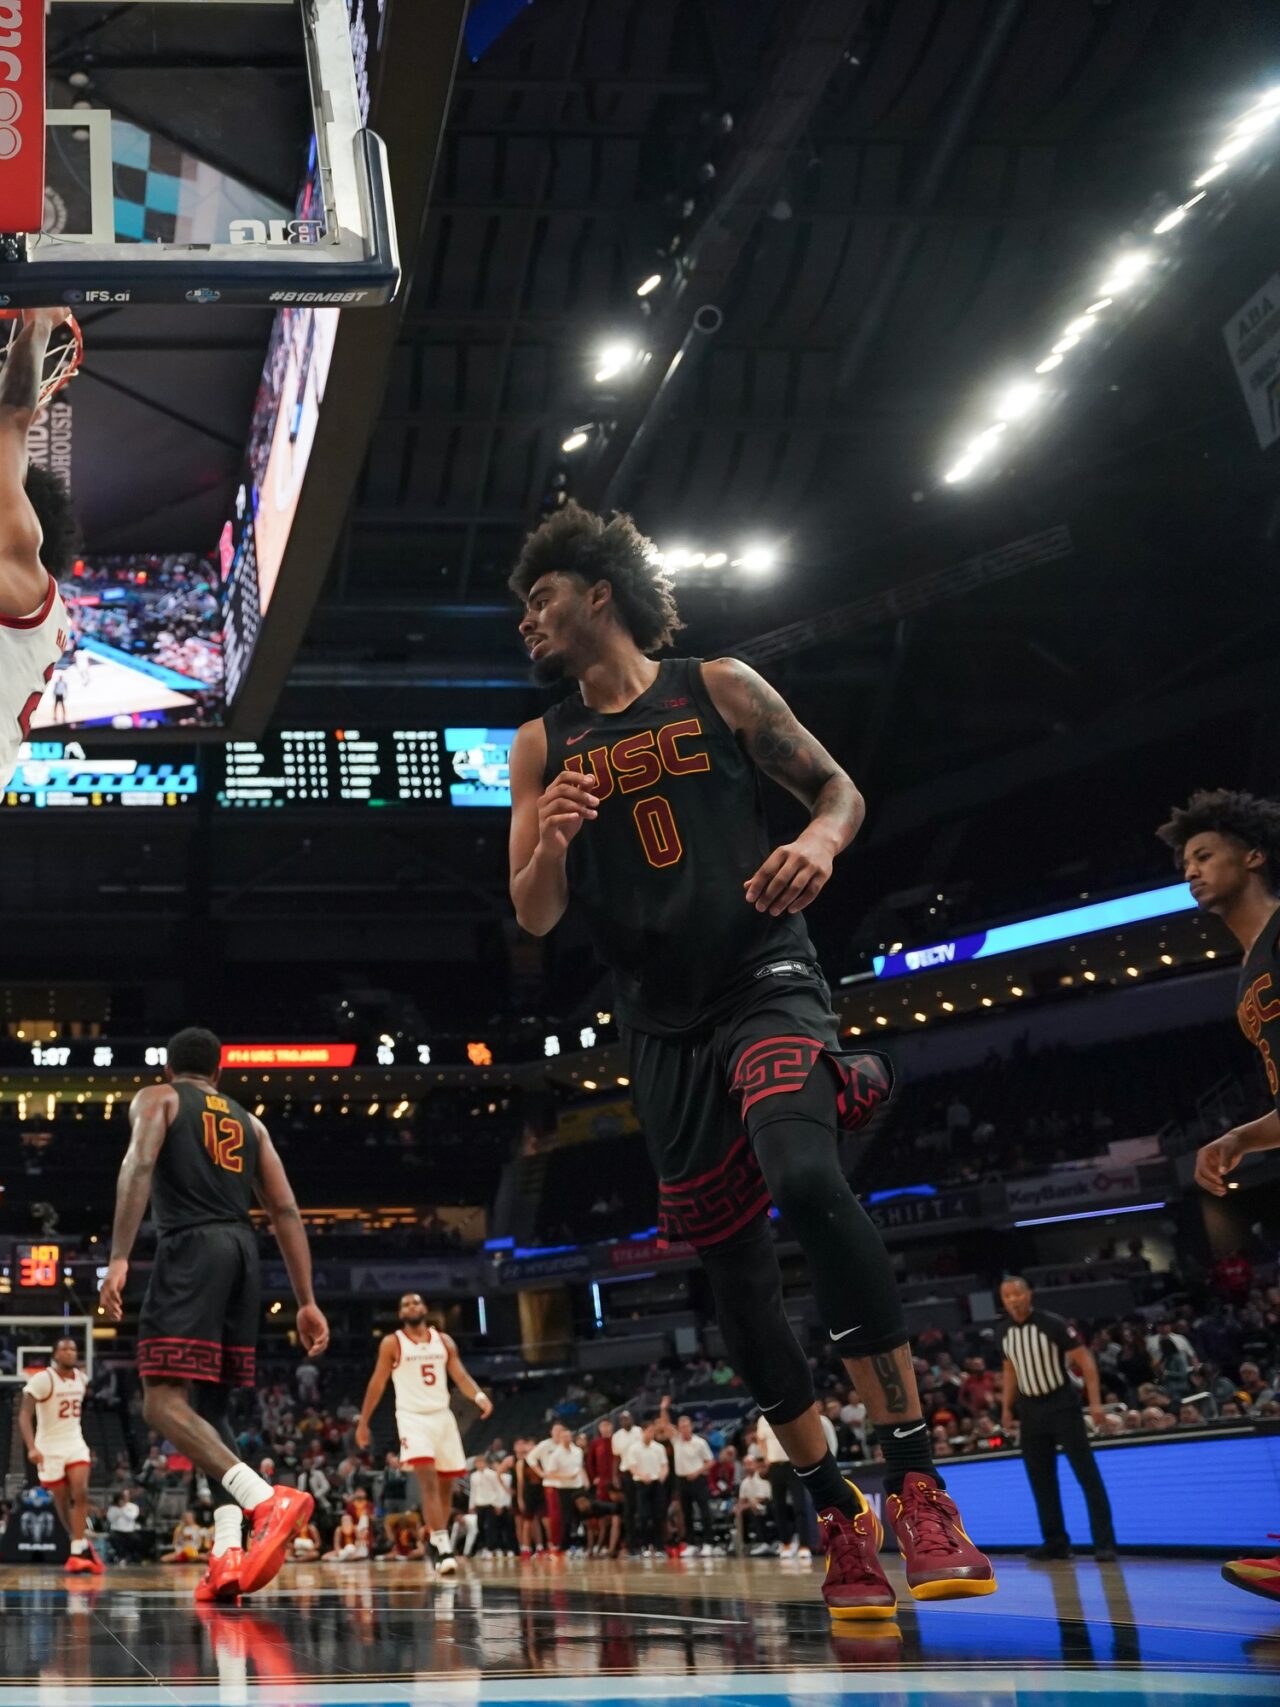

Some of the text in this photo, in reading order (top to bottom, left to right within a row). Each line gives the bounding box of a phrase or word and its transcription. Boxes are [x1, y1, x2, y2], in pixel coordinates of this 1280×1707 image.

[85, 290, 131, 302] IFS.ai
[564, 718, 710, 802] USC
[633, 795, 682, 868] 0
[202, 1111, 244, 1173] 12
[421, 1364, 436, 1386] 5
